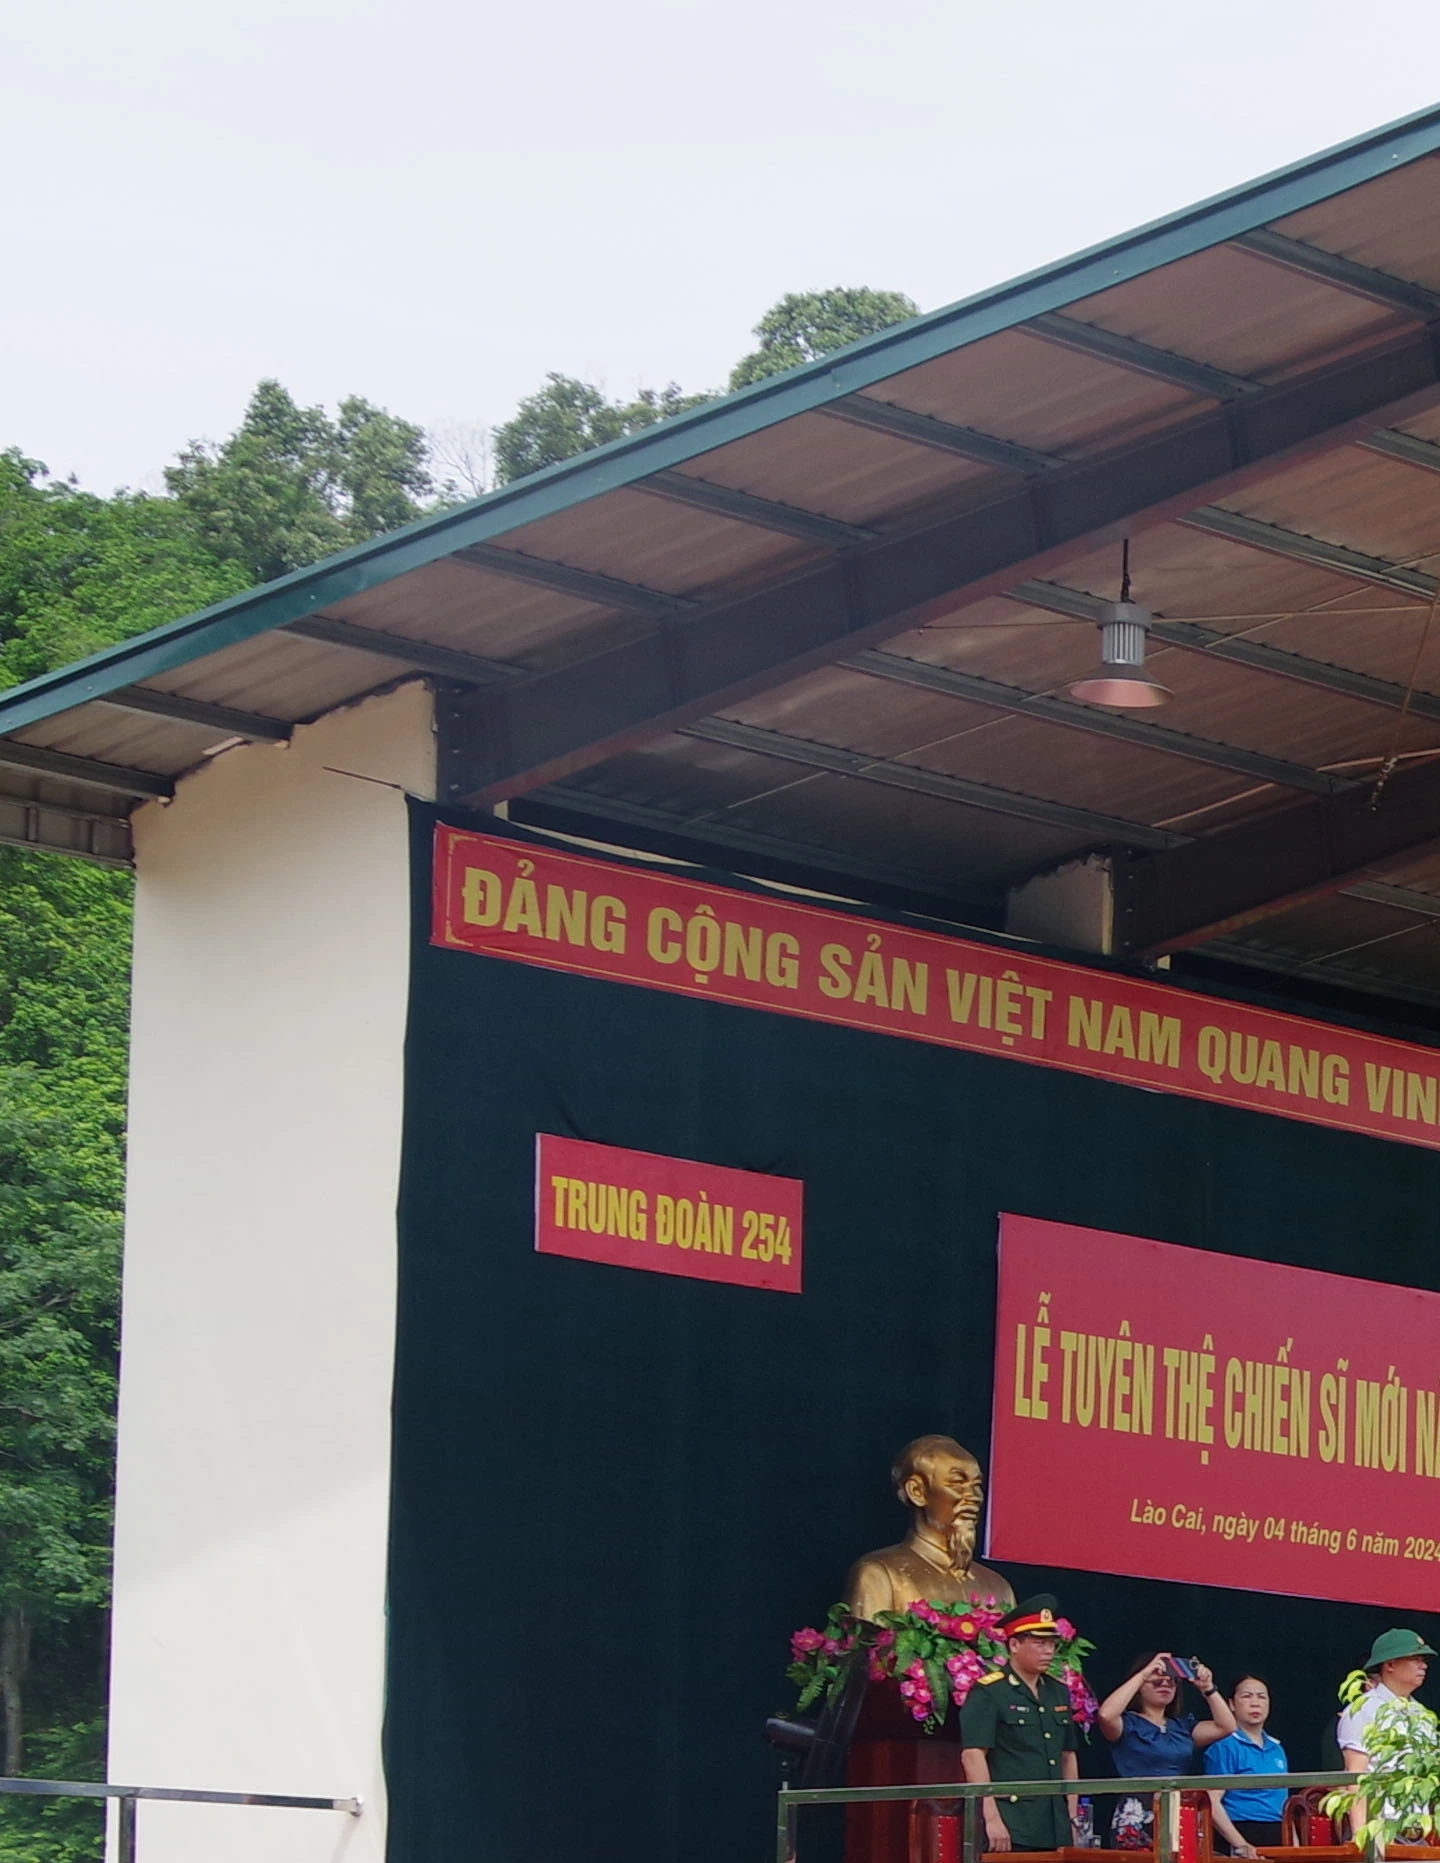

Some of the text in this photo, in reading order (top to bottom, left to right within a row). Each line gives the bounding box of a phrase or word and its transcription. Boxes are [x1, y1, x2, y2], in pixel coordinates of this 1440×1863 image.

[461, 859, 627, 954] ĐẢNG
[647, 904, 800, 989] CỘNG
[818, 933, 928, 1015] SẢN
[946, 968, 1052, 1045] VIỆT
[1067, 995, 1181, 1068] NAM
[1197, 1025, 1350, 1105] QUANG
[551, 1175, 793, 1265] TRUNG ĐOÀN 254
[1014, 1293, 1051, 1420] LỄ
[1059, 1320, 1155, 1435] TUYÊN
[1163, 1334, 1216, 1464] THỆ
[1223, 1340, 1311, 1458] CHIẾN
[1318, 1359, 1349, 1463] SĨ
[1354, 1367, 1408, 1473] MỚI
[1129, 1498, 1166, 1526] Lào
[1171, 1503, 1206, 1533] Cai,
[1212, 1511, 1259, 1540] ngày
[1263, 1517, 1286, 1540] 04
[1290, 1519, 1341, 1551] tháng
[1346, 1529, 1358, 1550] 6
[1362, 1532, 1400, 1556] năm
